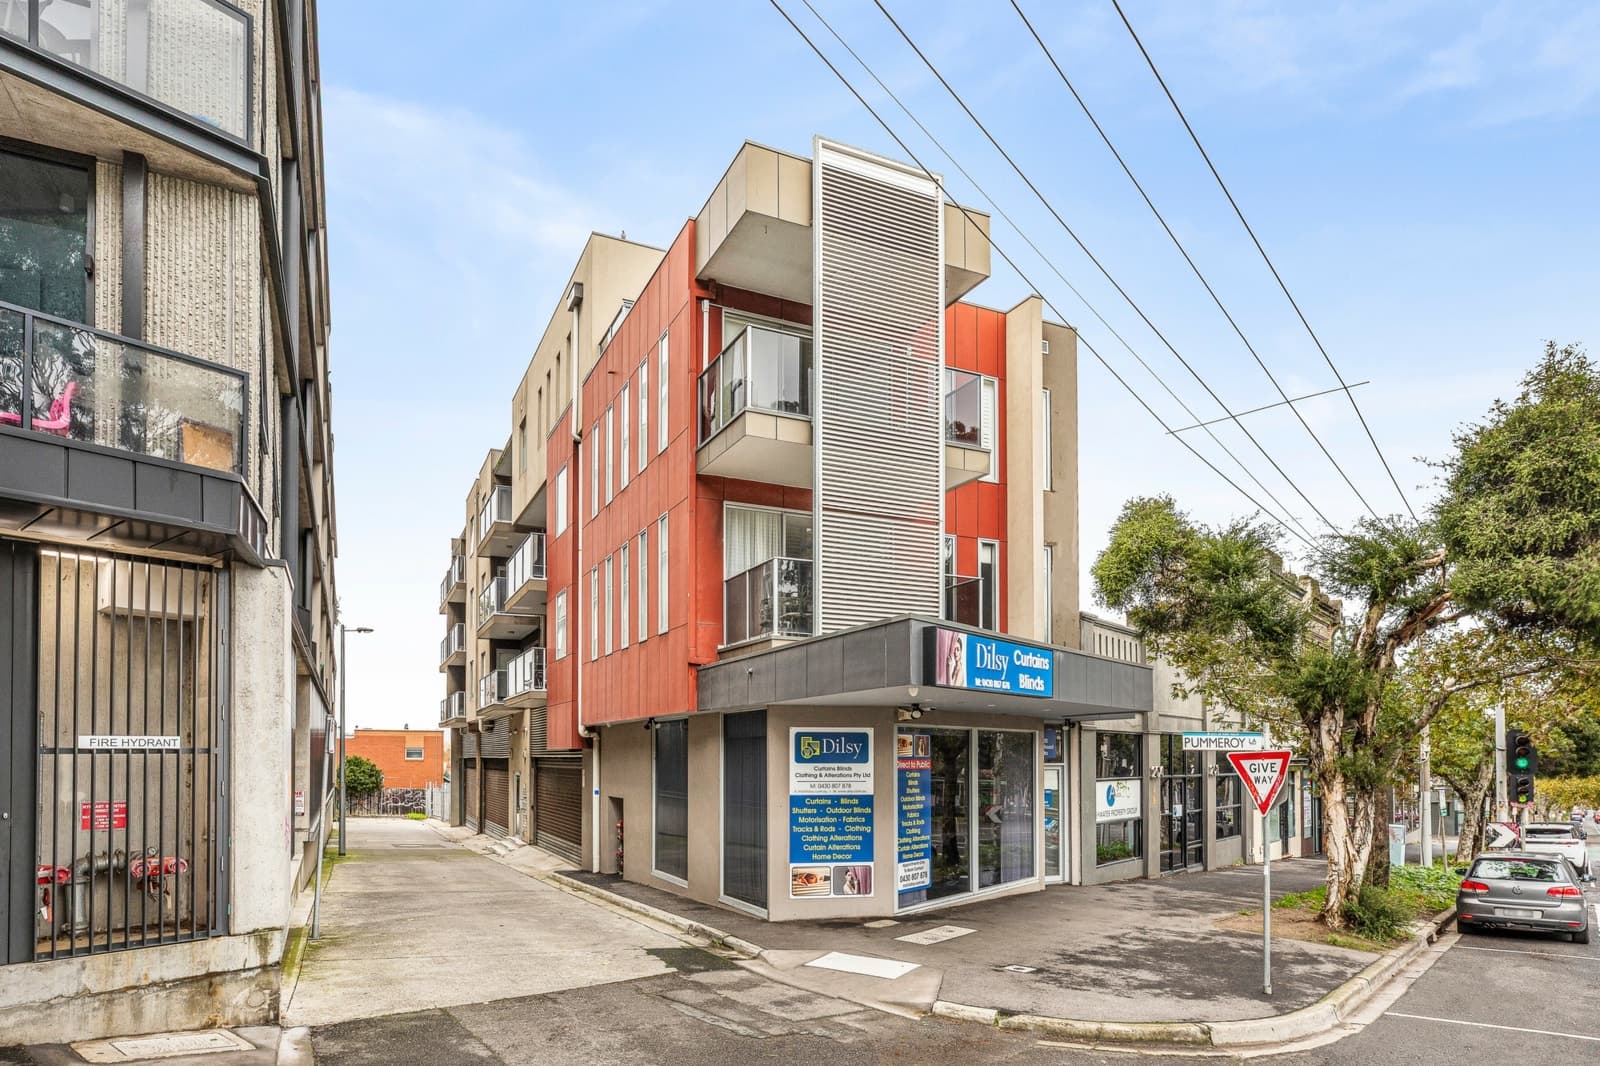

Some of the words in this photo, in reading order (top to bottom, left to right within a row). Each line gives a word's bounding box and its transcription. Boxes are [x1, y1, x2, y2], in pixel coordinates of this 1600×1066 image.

[976, 643, 1008, 680] Dilsy
[1014, 650, 1050, 670] Curtains
[1018, 674, 1044, 691] Blinds
[90, 738, 118, 747] FIRE
[122, 738, 178, 747] HYDRANT
[822, 736, 862, 759] Dilsy
[1184, 737, 1246, 748] PUMMEROY
[1250, 762, 1278, 772] GIVE
[1254, 775, 1274, 784] WAY
